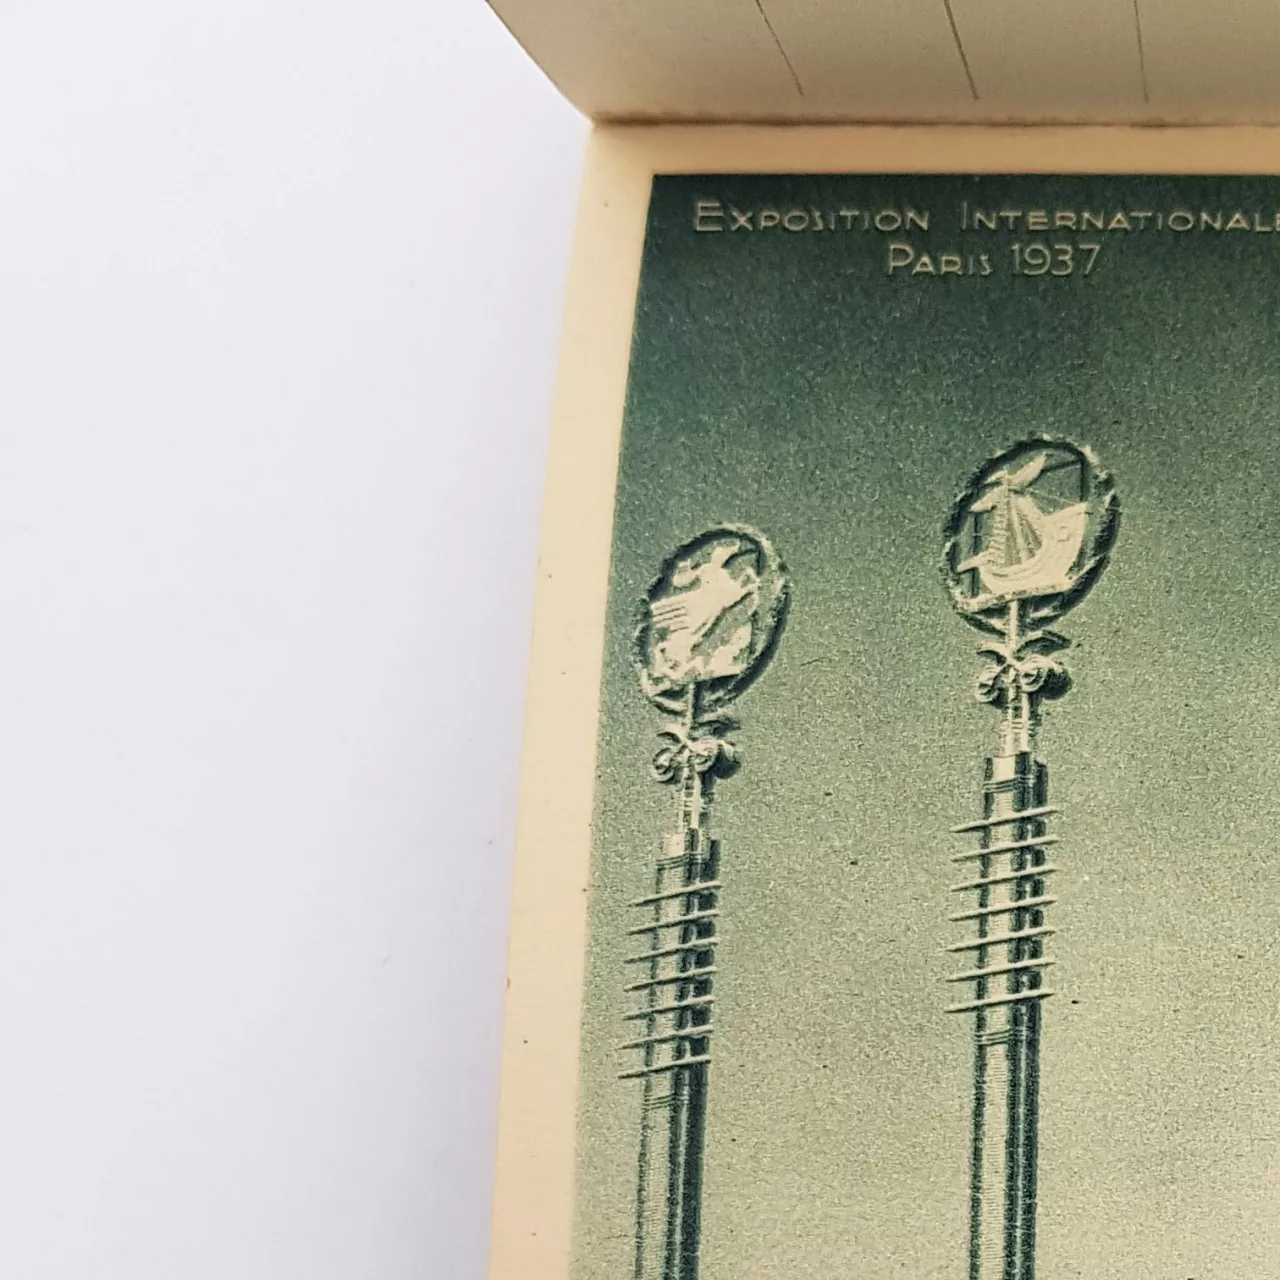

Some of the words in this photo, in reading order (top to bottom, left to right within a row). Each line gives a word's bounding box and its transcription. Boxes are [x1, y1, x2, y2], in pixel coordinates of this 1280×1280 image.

[695, 200, 930, 232] EXPOSITION
[887, 243, 992, 276] PARIS
[1011, 244, 1101, 276] 1937
